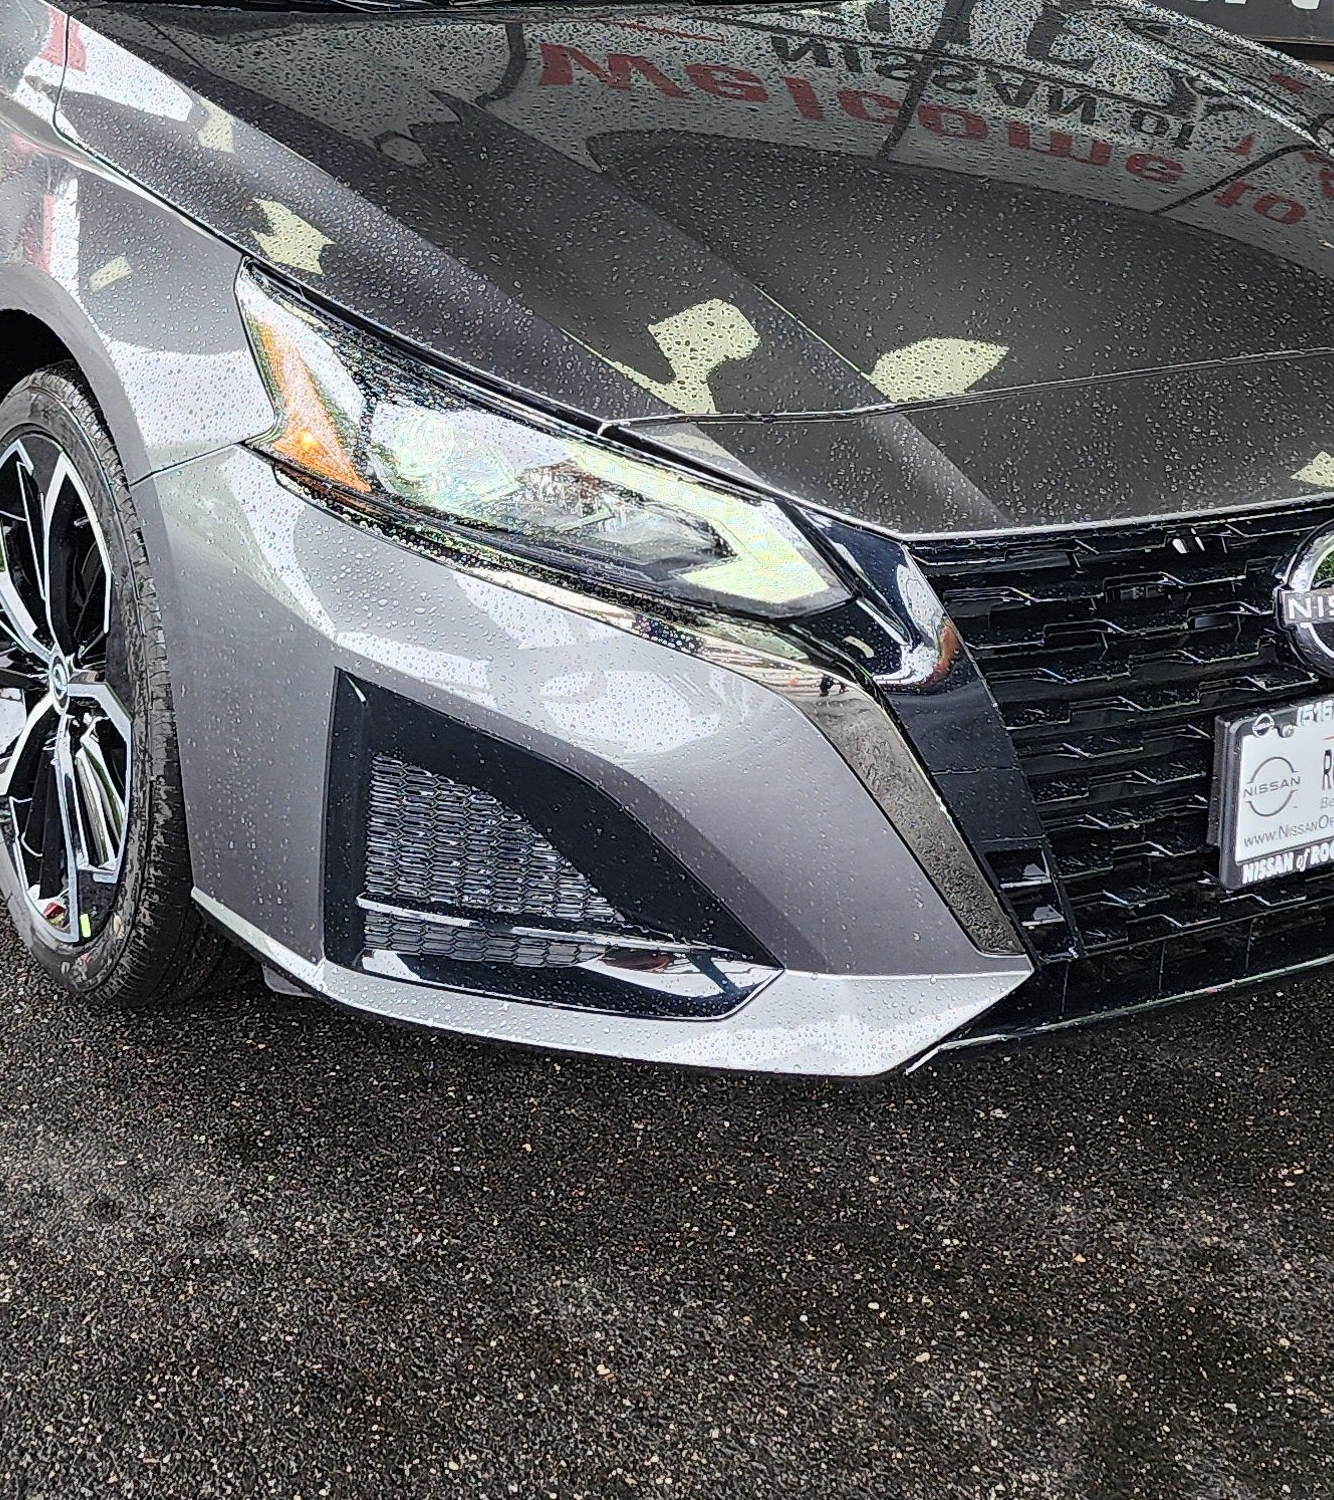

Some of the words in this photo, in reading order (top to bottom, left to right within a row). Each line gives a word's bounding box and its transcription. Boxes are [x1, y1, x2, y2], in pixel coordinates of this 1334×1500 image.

[1242, 776, 1302, 798] NISSAN
[1242, 852, 1294, 885] NISSAN
[1296, 847, 1311, 873] of
